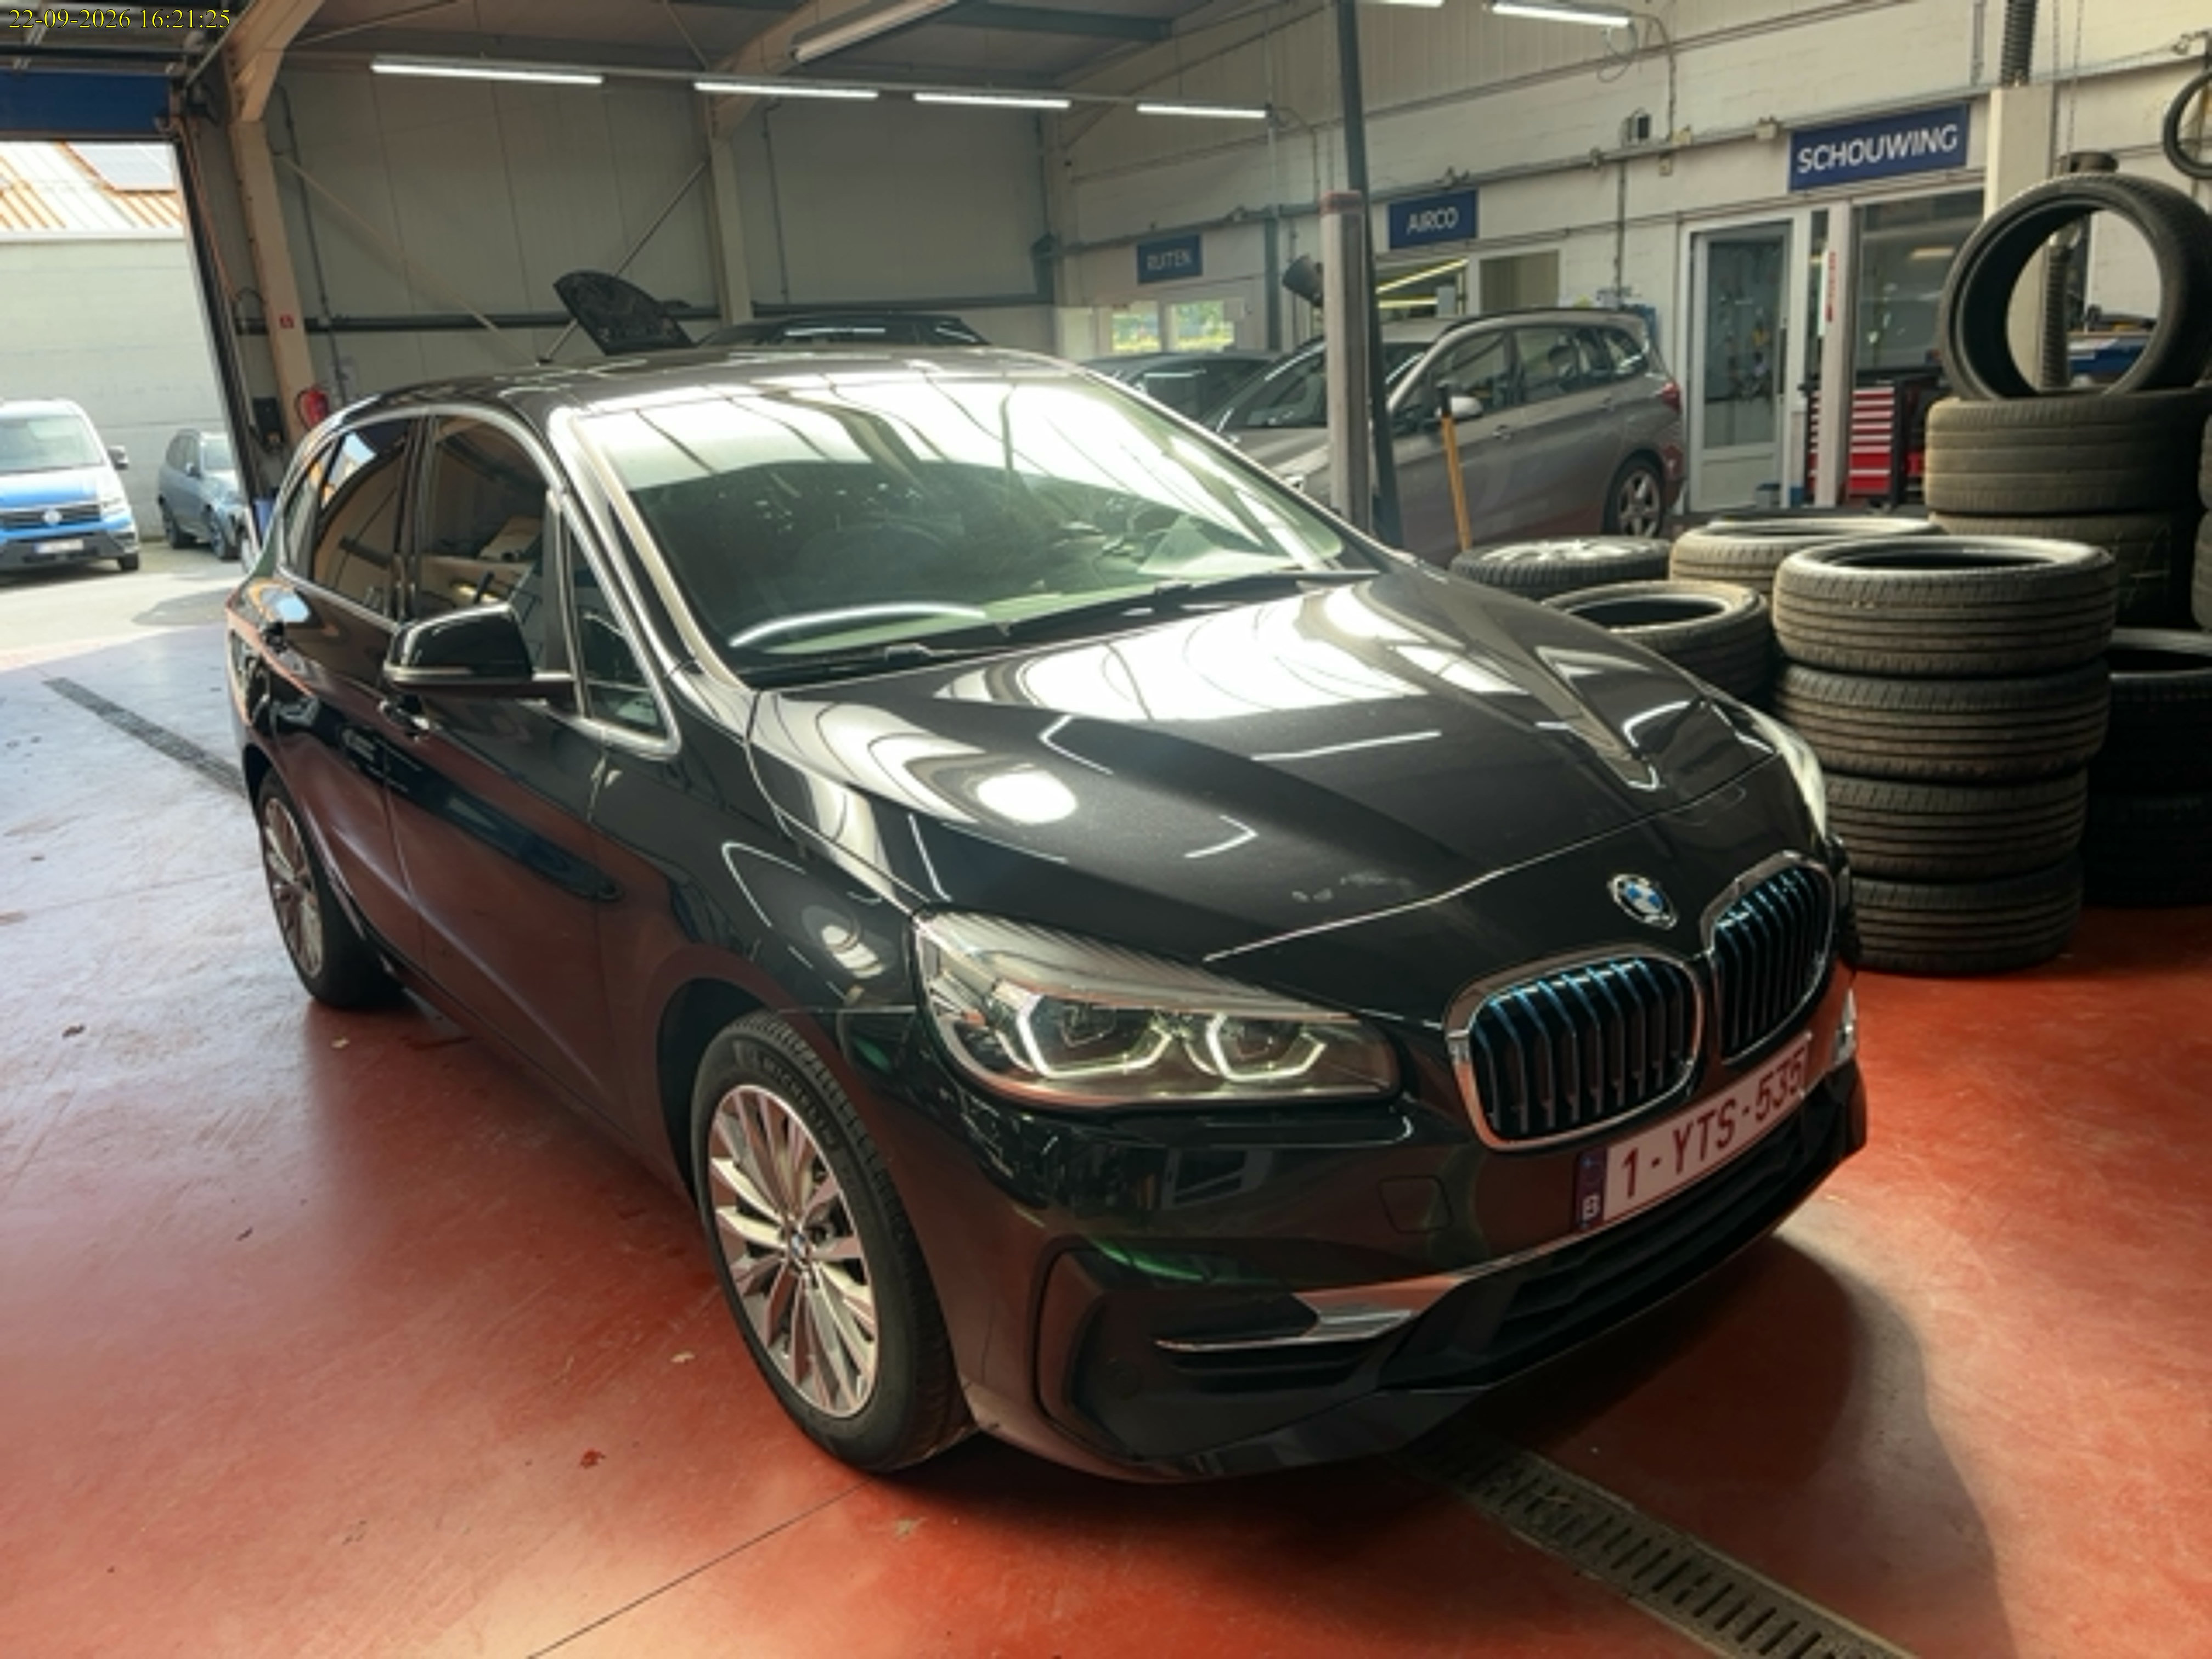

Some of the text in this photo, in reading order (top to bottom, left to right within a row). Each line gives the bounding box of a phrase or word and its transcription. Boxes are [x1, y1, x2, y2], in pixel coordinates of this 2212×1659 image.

[1796, 123, 1958, 174] SCHOUWING
[1406, 206, 1460, 236] AIRCO
[1582, 1194, 1601, 1221] B
